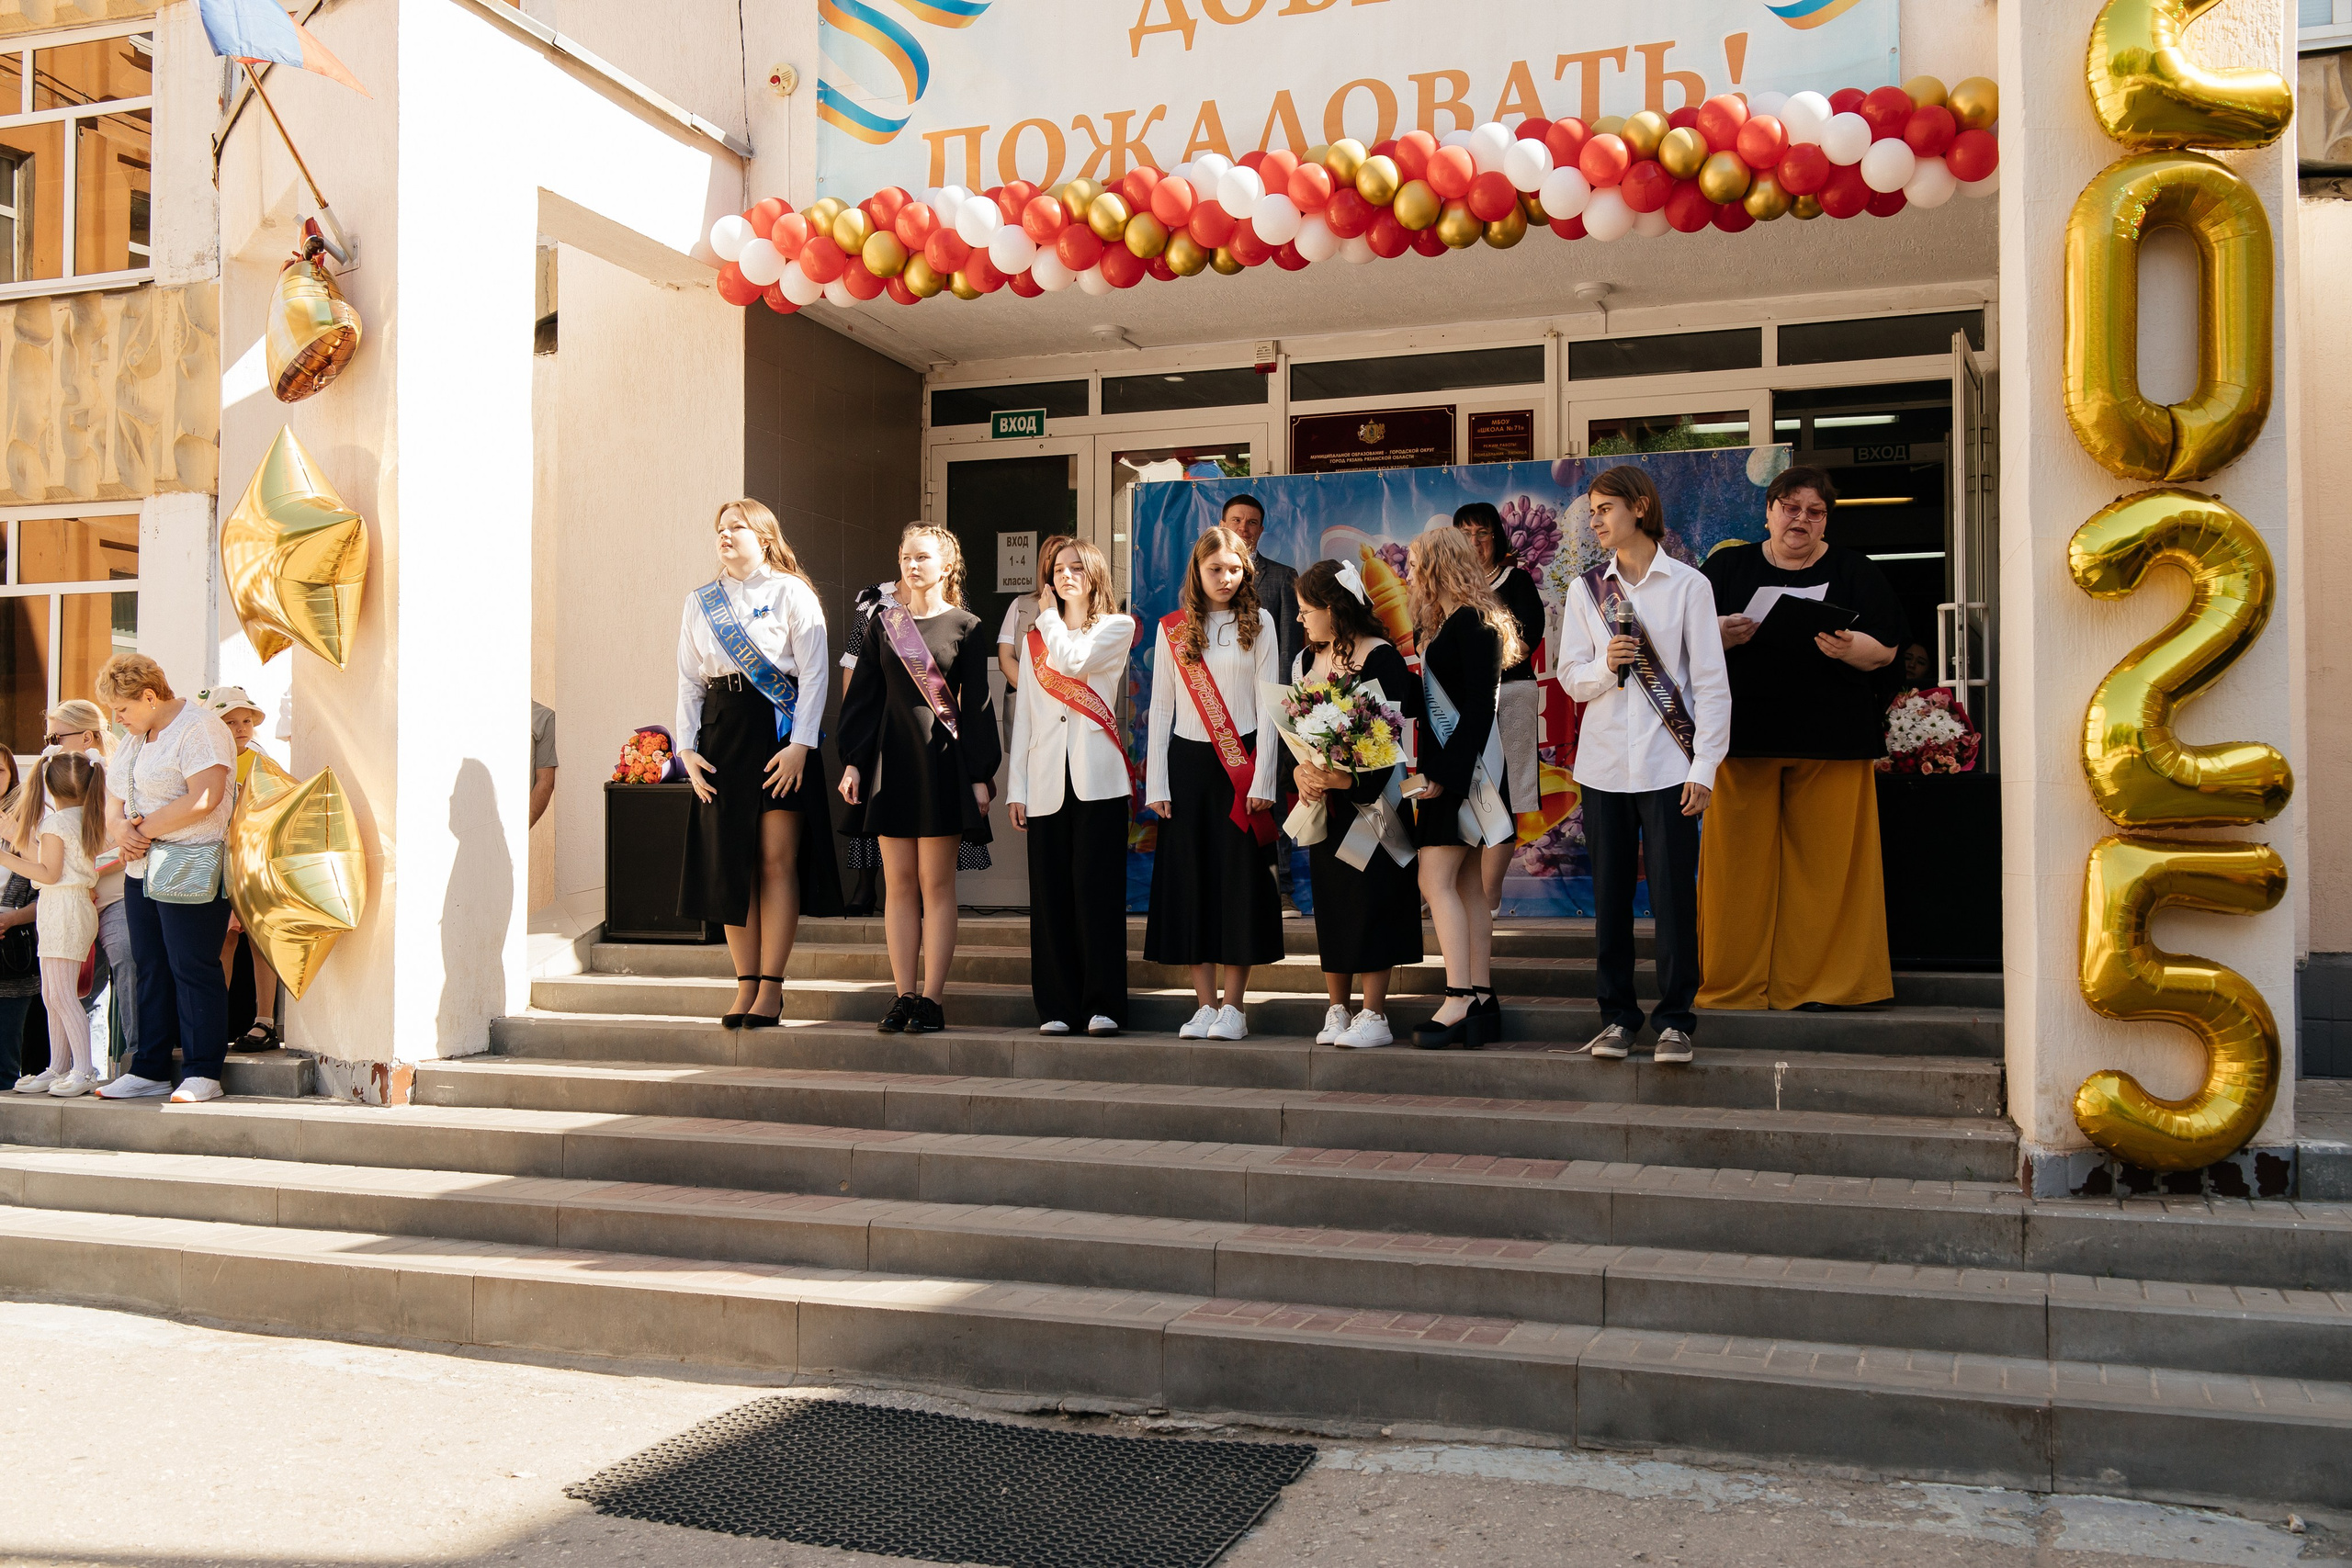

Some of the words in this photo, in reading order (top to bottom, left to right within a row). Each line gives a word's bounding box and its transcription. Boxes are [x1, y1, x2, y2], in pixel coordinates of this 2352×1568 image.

[922, 32, 1749, 197] ПОЖАЛОВАТЬ!
[1000, 416, 1036, 434] ВХОД
[1476, 425, 1505, 434] «ШКОЛА
[1858, 445, 1906, 461] ВХОД
[1006, 536, 1029, 547] ВХОД
[1010, 556, 1014, 567] 1
[1021, 555, 1026, 566] 4
[1002, 576, 1033, 587] классы
[701, 585, 768, 679] ВЫПУСКНИК
[1214, 728, 1248, 767] 2025
